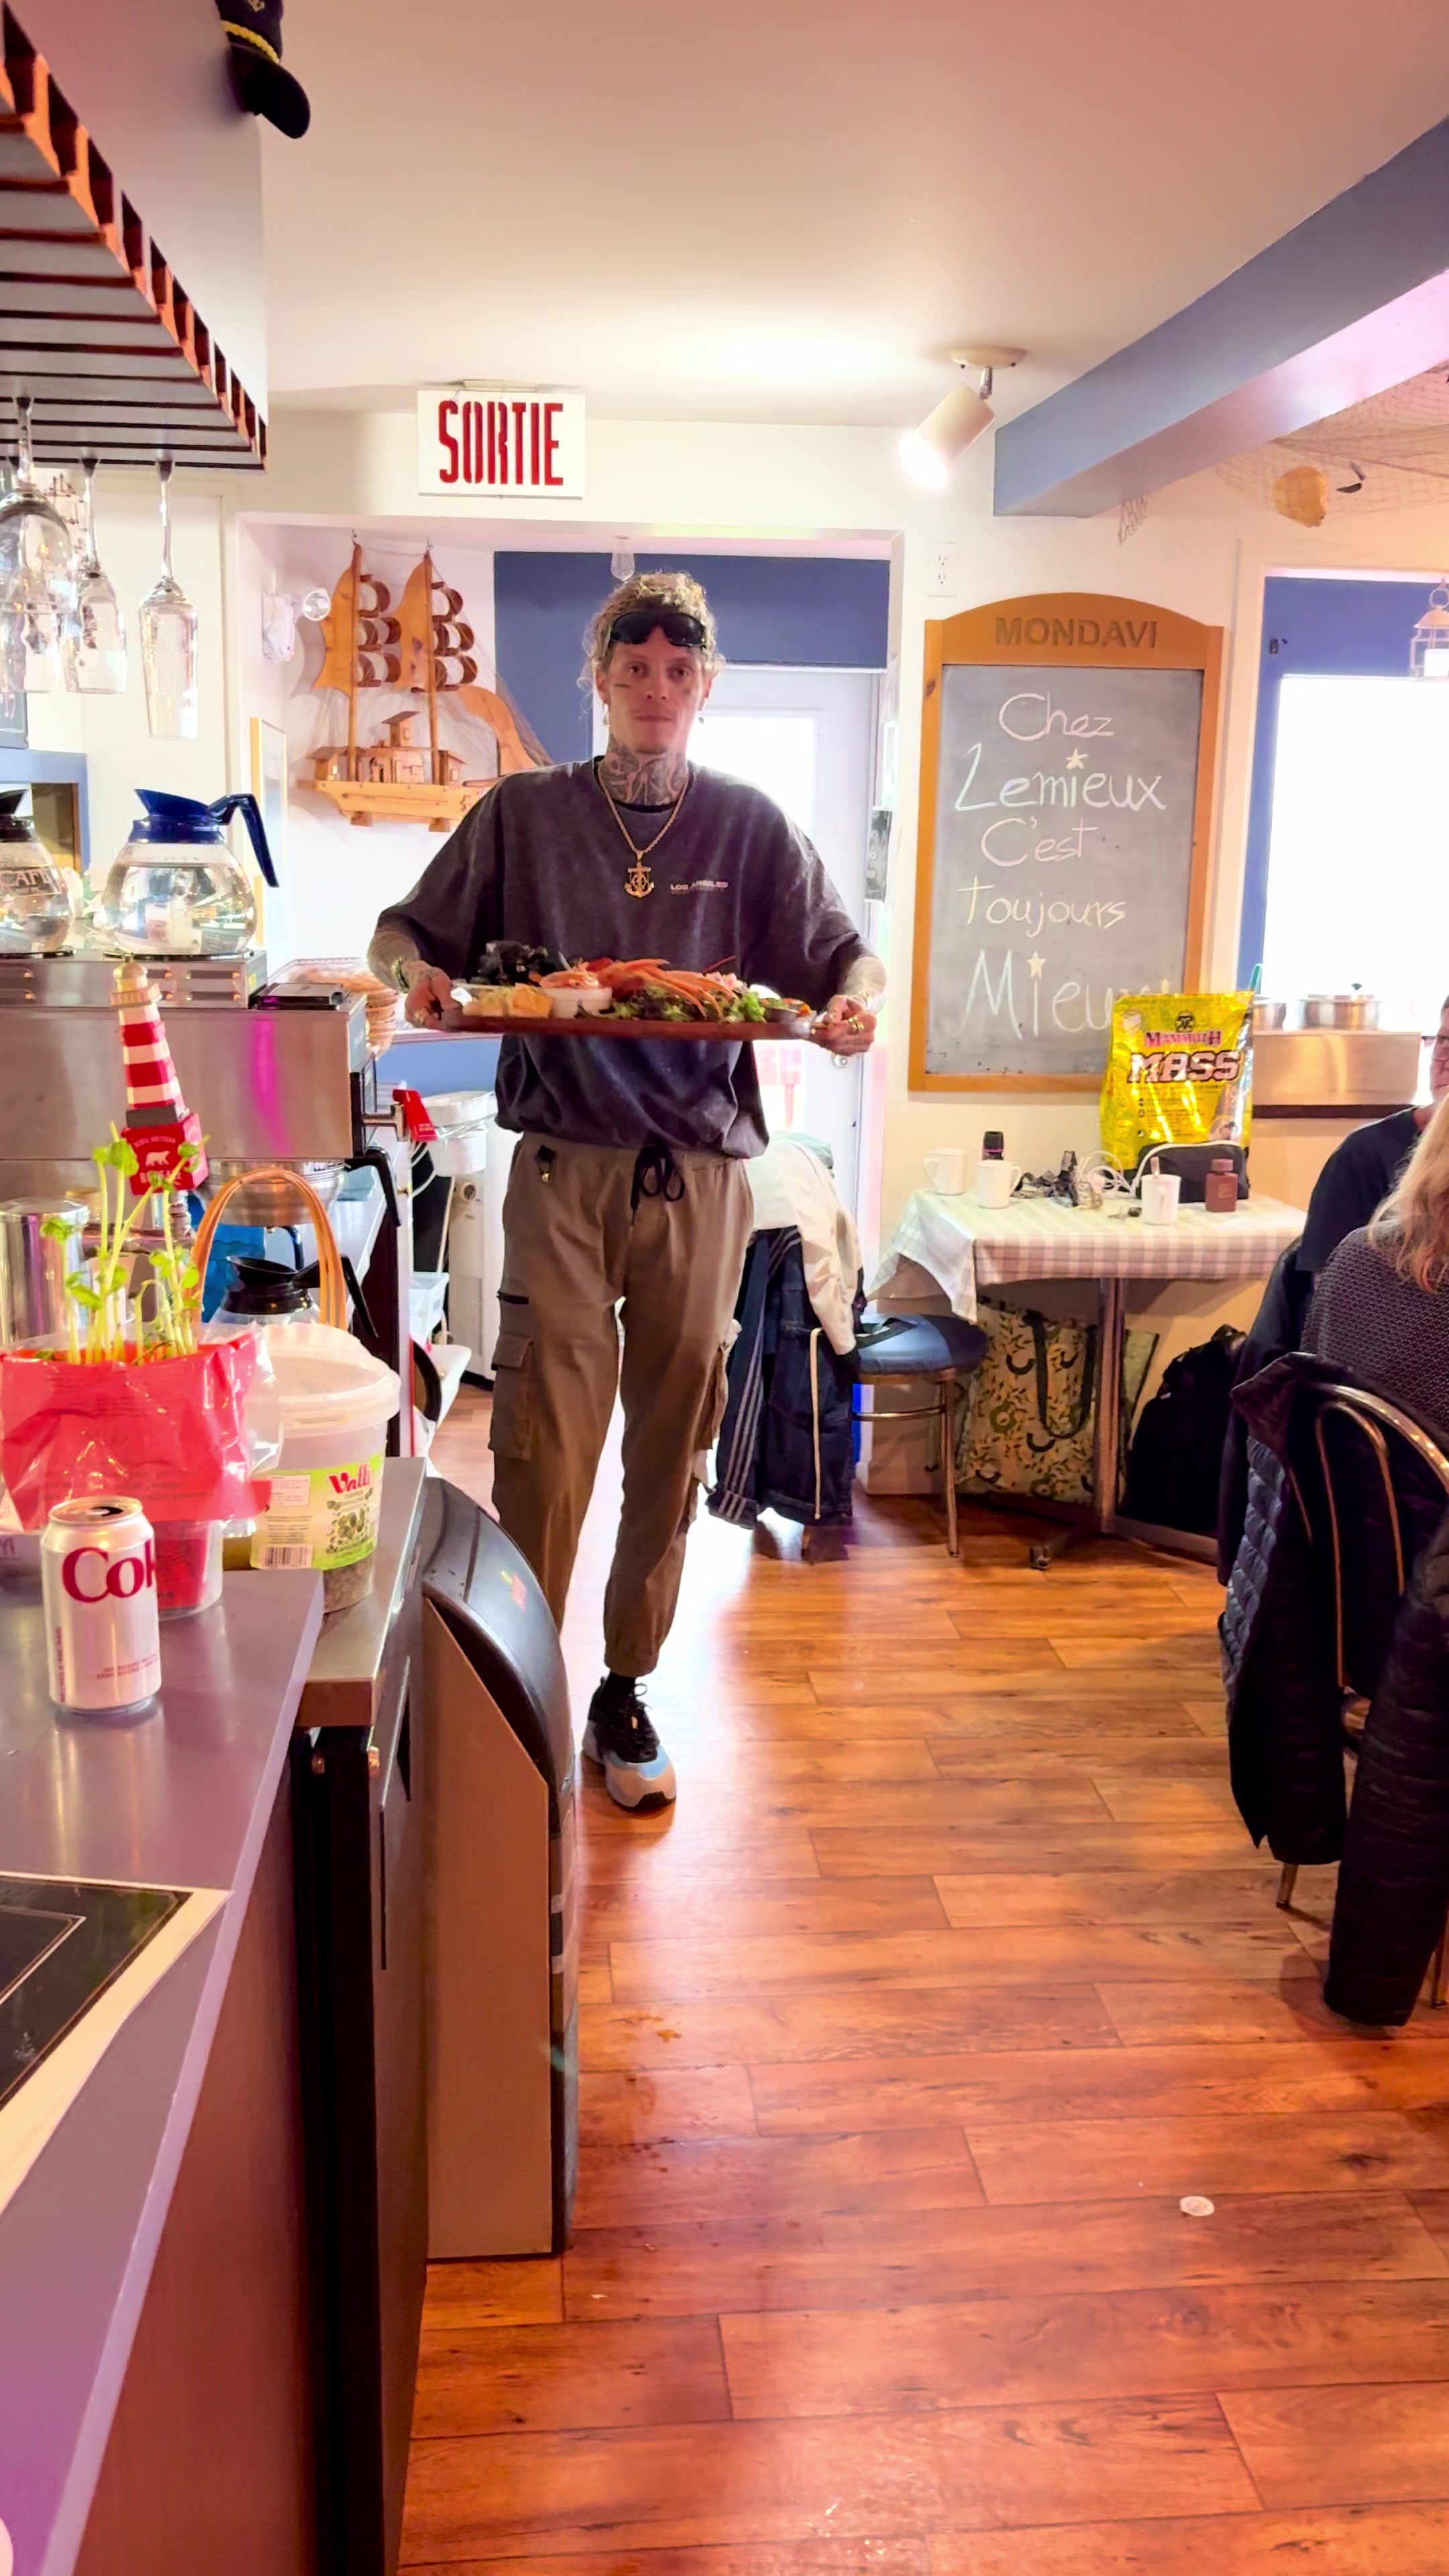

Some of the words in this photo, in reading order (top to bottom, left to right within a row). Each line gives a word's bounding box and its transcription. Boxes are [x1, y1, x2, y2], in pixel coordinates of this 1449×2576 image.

[439, 400, 564, 485] SORTIE
[994, 617, 1158, 649] MONDAVI
[998, 691, 1116, 741] Chez
[954, 742, 1167, 812] Lemieux
[981, 816, 1099, 867] C'est
[1127, 1050, 1241, 1084] MASS
